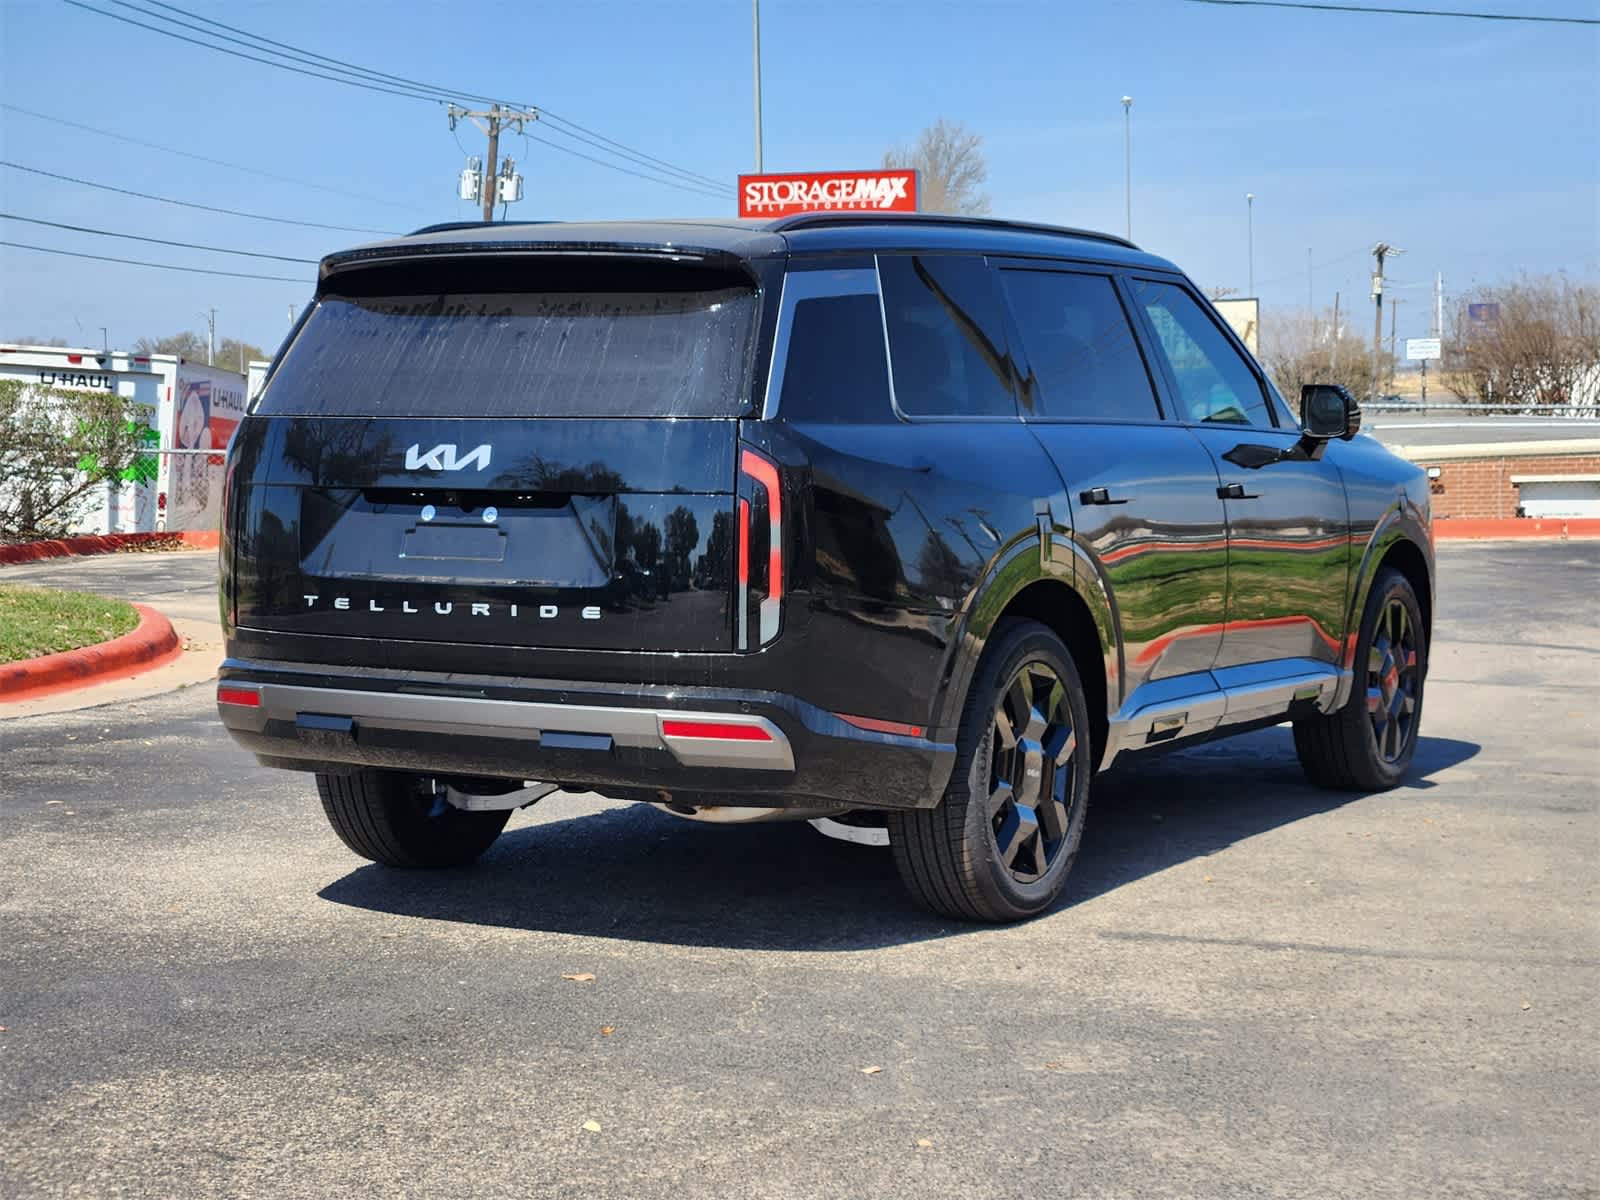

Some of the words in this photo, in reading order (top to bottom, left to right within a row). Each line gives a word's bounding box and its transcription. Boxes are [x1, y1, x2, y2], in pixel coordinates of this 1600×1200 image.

[745, 177, 908, 207] STORAGEMAX
[40, 372, 113, 389] U-HAUL
[213, 387, 244, 412] U-HAUL
[405, 444, 491, 471] KIA
[303, 594, 602, 620] TELLURIDE
